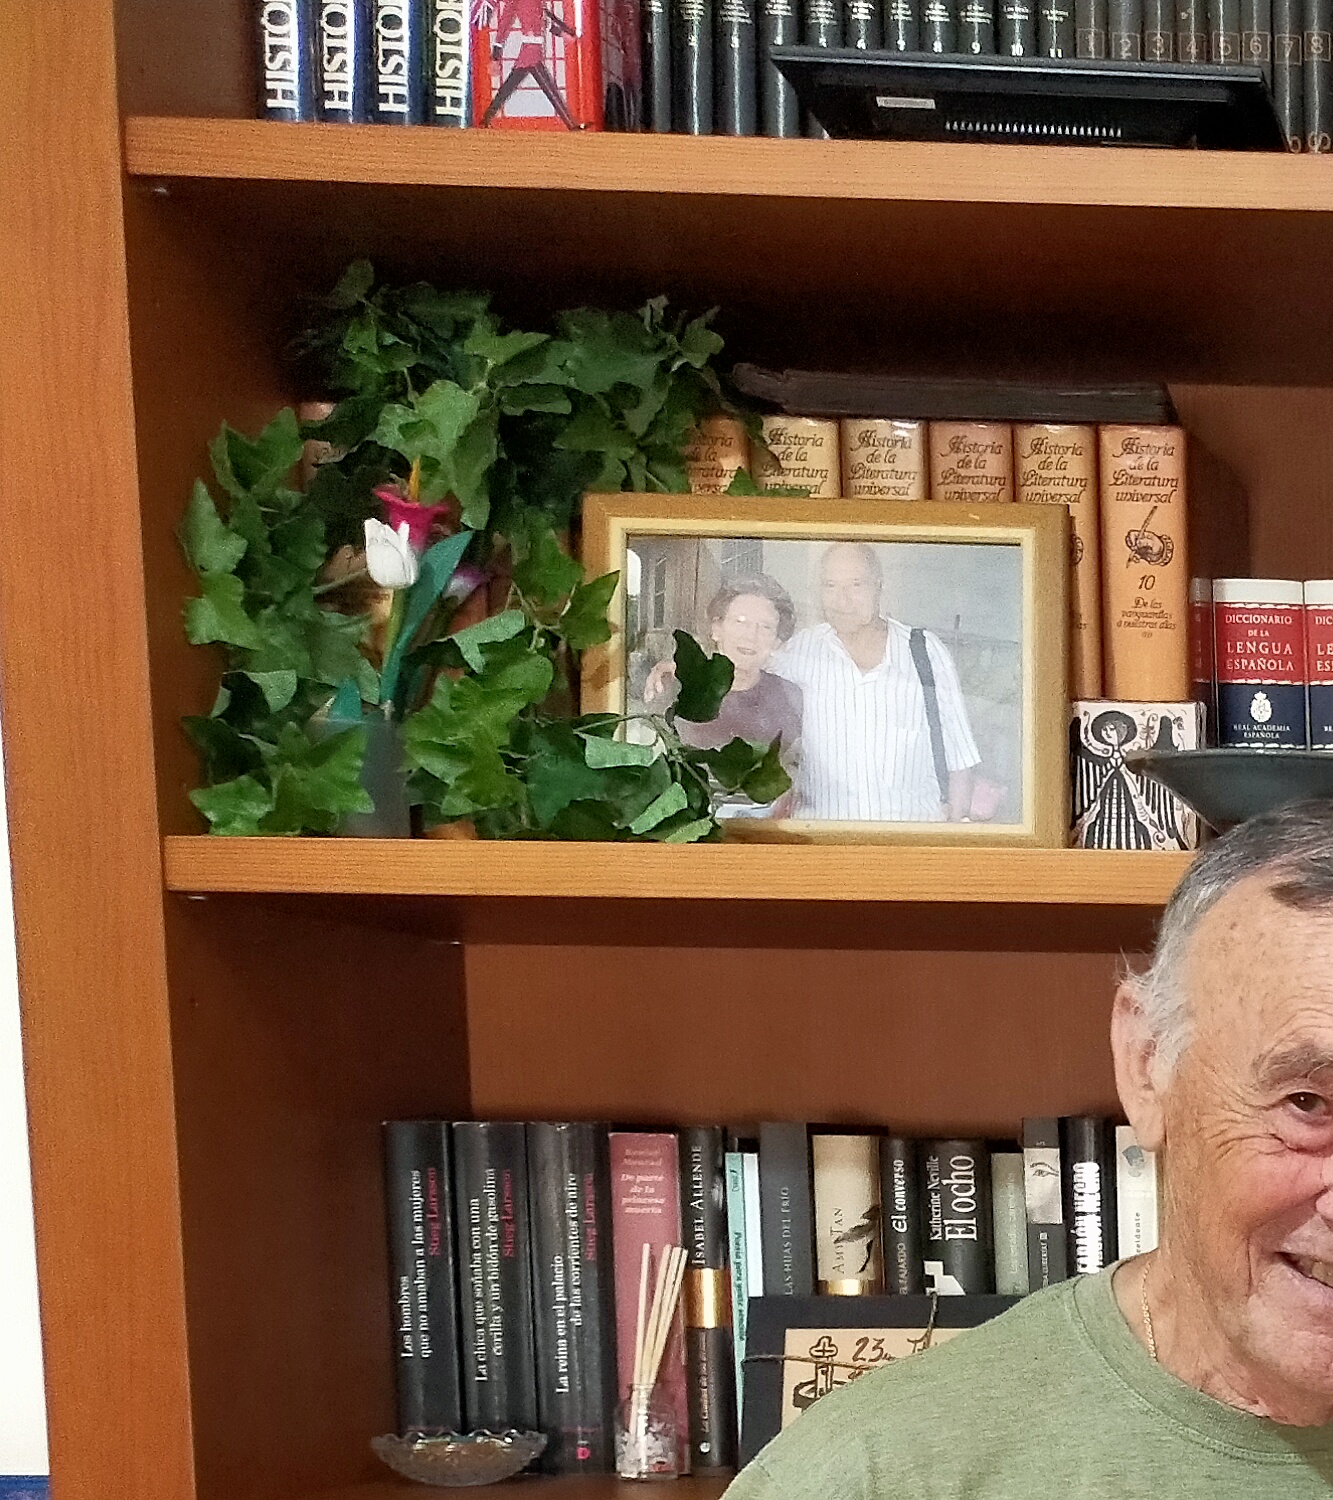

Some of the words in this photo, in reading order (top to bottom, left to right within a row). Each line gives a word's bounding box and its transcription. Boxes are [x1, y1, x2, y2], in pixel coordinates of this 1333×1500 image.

[262, 0, 297, 109] HISTO
[321, 0, 353, 109] HISTO
[377, 0, 408, 112] HISTO
[434, 0, 464, 115] HISTO
[850, 429, 912, 450] Historia
[940, 435, 1003, 456] Historia
[1023, 437, 1083, 459] Historia
[1111, 438, 1175, 459] Historia
[849, 462, 916, 480] Literatura
[938, 468, 1006, 486] Literatura
[1019, 471, 1087, 489] Literatura
[1108, 471, 1178, 488] Literatura
[854, 483, 910, 496] universal
[1115, 490, 1176, 504] universal
[1138, 575, 1155, 590] 10
[1225, 614, 1293, 625] DICCIONARIO
[1248, 629, 1258, 637] DE
[1259, 629, 1269, 637] LA
[1226, 642, 1293, 656] LENGUA
[1227, 656, 1294, 672] ESPAÑOLA
[689, 1145, 704, 1209] ALLENDE
[927, 1155, 940, 1190] Neville
[892, 1159, 906, 1211] converso
[941, 1155, 977, 1213] ocho
[1073, 1161, 1101, 1213] NEGRO
[410, 1171, 425, 1222] mujeres
[779, 1187, 790, 1212] FRÍO
[469, 1199, 480, 1223] una
[830, 1207, 843, 1236] TAN
[929, 1192, 942, 1240] Katherine
[782, 1219, 791, 1237] DEL
[891, 1215, 907, 1232] El
[943, 1217, 977, 1240] El
[411, 1226, 425, 1244] las
[472, 1227, 482, 1249] con
[691, 1215, 707, 1267] ISABEL
[416, 1248, 425, 1256] a
[783, 1242, 792, 1271] HIJAS
[413, 1260, 428, 1312] amaban
[470, 1252, 484, 1298] soñaba
[551, 1255, 567, 1301] palacio
[784, 1276, 793, 1295] LAS
[398, 1276, 412, 1331] hombres
[474, 1300, 489, 1325] que
[552, 1304, 565, 1316] el
[418, 1314, 429, 1330] no
[557, 1320, 566, 1336] en
[400, 1334, 414, 1357] Los
[418, 1334, 433, 1358] que
[474, 1328, 486, 1361] chica
[555, 1339, 568, 1372] reina
[475, 1364, 488, 1381] La
[556, 1375, 569, 1393] La
